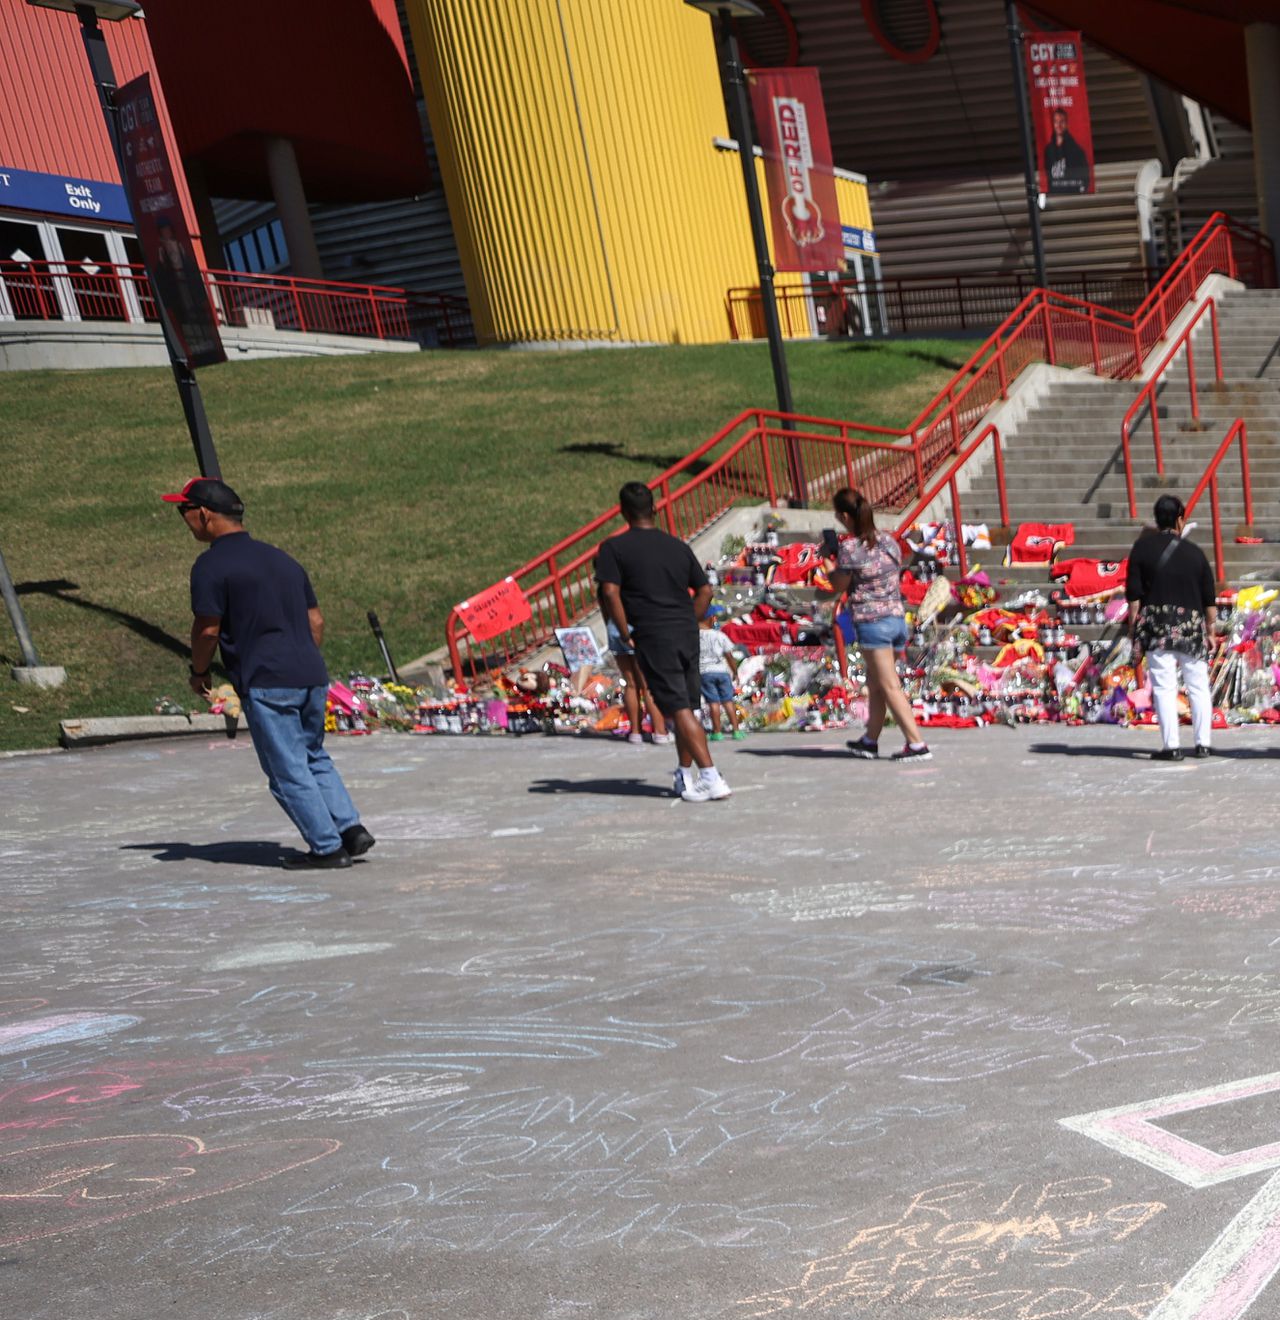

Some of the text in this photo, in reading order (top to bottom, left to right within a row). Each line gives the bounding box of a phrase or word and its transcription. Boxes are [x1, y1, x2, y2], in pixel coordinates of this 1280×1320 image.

[778, 104, 803, 162] RED
[65, 183, 92, 198] Exit
[69, 196, 101, 213] Only
[897, 1174, 1112, 1223] RIP
